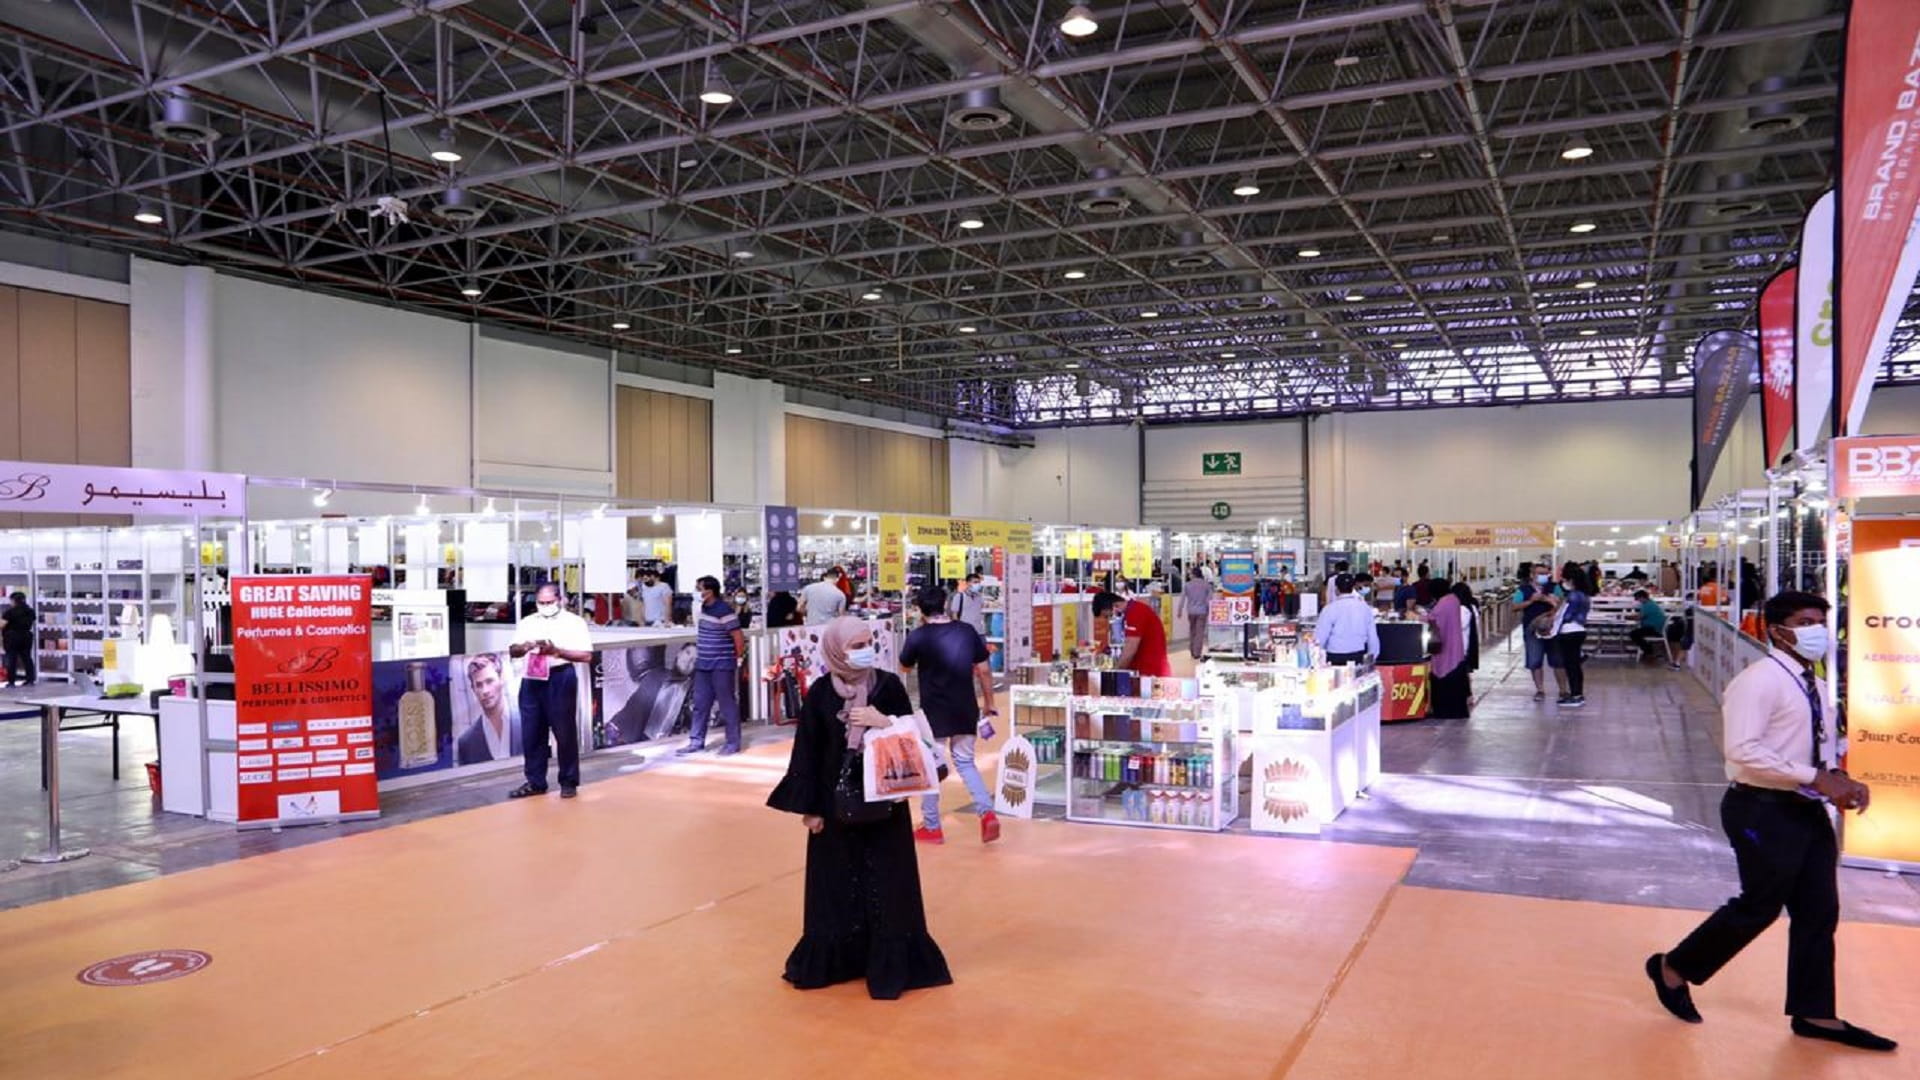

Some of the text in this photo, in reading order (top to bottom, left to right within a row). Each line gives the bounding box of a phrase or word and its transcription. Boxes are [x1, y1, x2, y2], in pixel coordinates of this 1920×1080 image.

[1862, 119, 1907, 220] BRAND
[82, 479, 226, 509] بليسيمو
[240, 584, 362, 602] GREAT SAVING
[251, 605, 353, 619] HUGE Collection
[237, 624, 366, 638] Perfumes & Cosmetics
[251, 678, 360, 695] BELLISSIMO
[242, 697, 296, 707] PERFUMES
[311, 694, 367, 704] COSMETICS
[1857, 729, 1894, 743] Juicy
